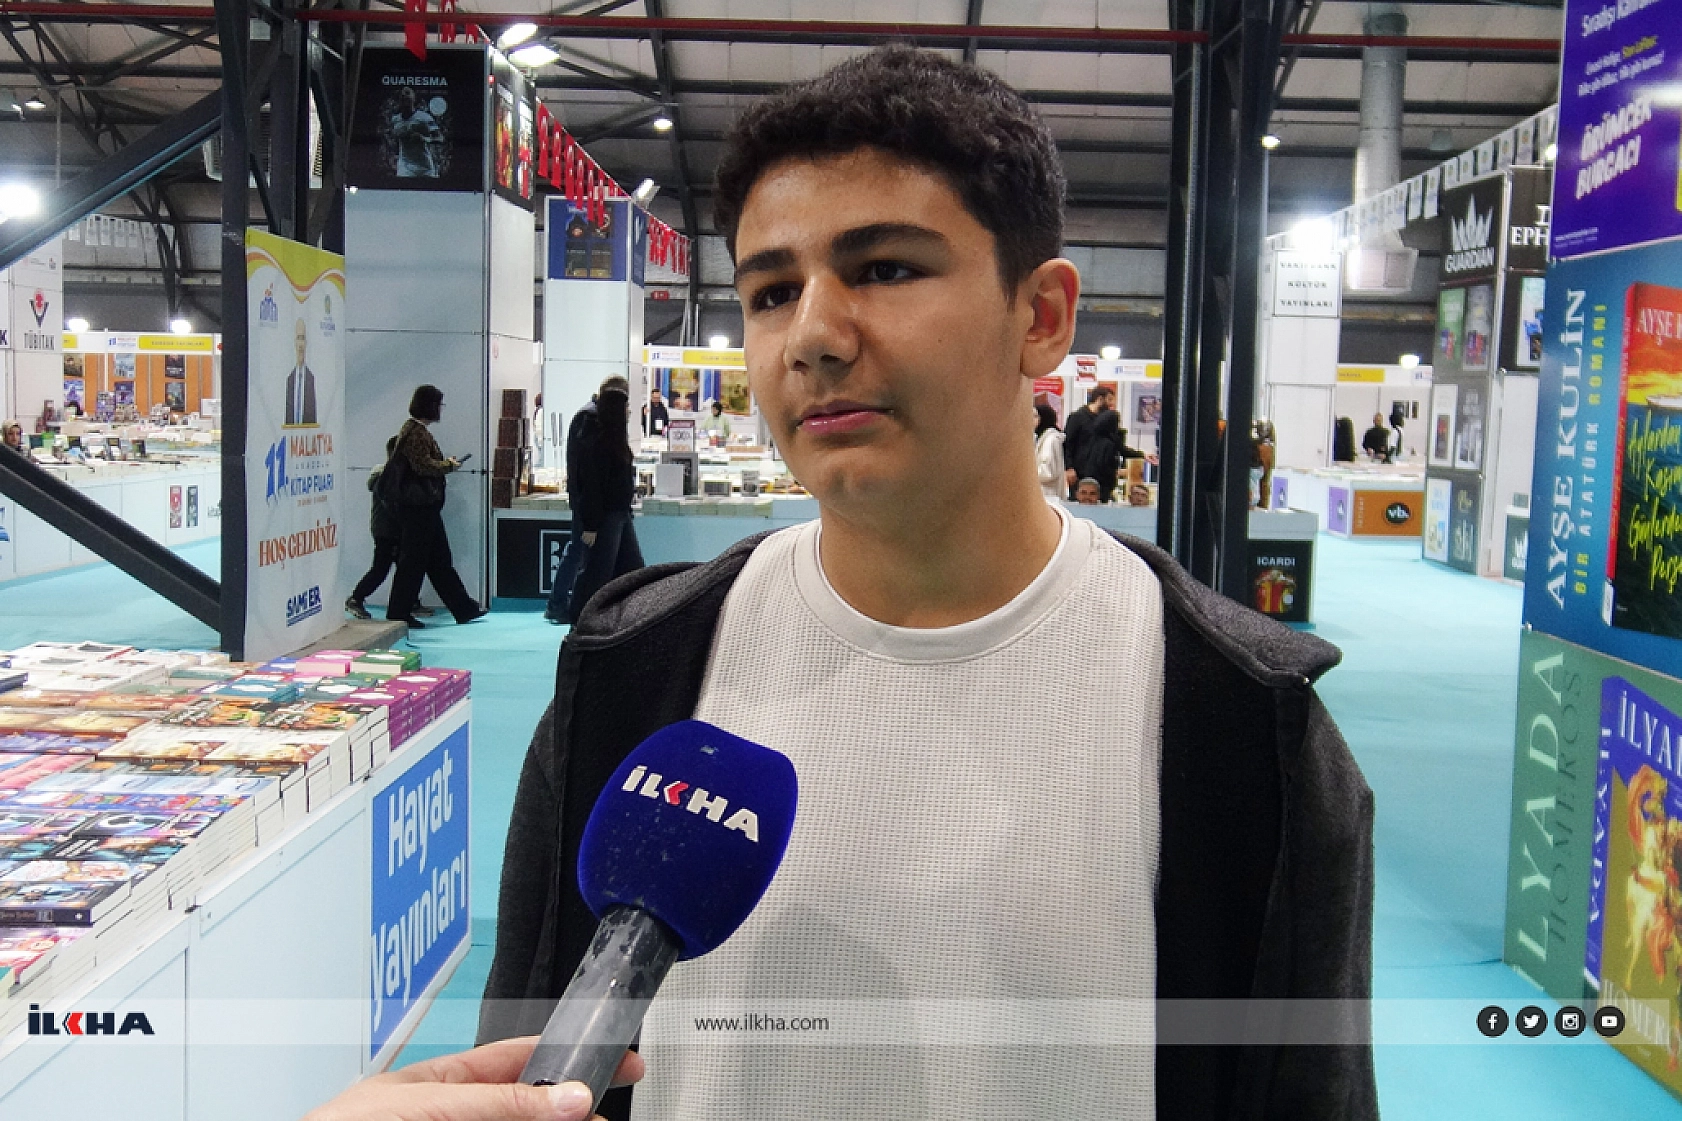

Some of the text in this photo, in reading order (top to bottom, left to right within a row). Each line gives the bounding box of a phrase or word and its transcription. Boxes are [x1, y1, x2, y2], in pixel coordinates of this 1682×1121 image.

[382, 75, 449, 86] QUARESMA
[1445, 247, 1494, 273] GUARDIAN
[1280, 299, 1333, 308] YAYINLARI
[23, 329, 55, 350] TÜBİTAK
[1637, 308, 1674, 347] AYŞE
[290, 433, 334, 458] MALATYA
[1547, 287, 1587, 610] AYŞE KULİN
[1574, 304, 1607, 595] BİR ATATÜRK ROMANI
[258, 516, 338, 570] HOŞ GELDİNİZ
[1256, 556, 1296, 567] ICARDI
[388, 748, 453, 877] Hayat
[621, 765, 760, 842] İLKHA
[1550, 670, 1581, 944] HOMEROS
[370, 850, 467, 1033] yayınları
